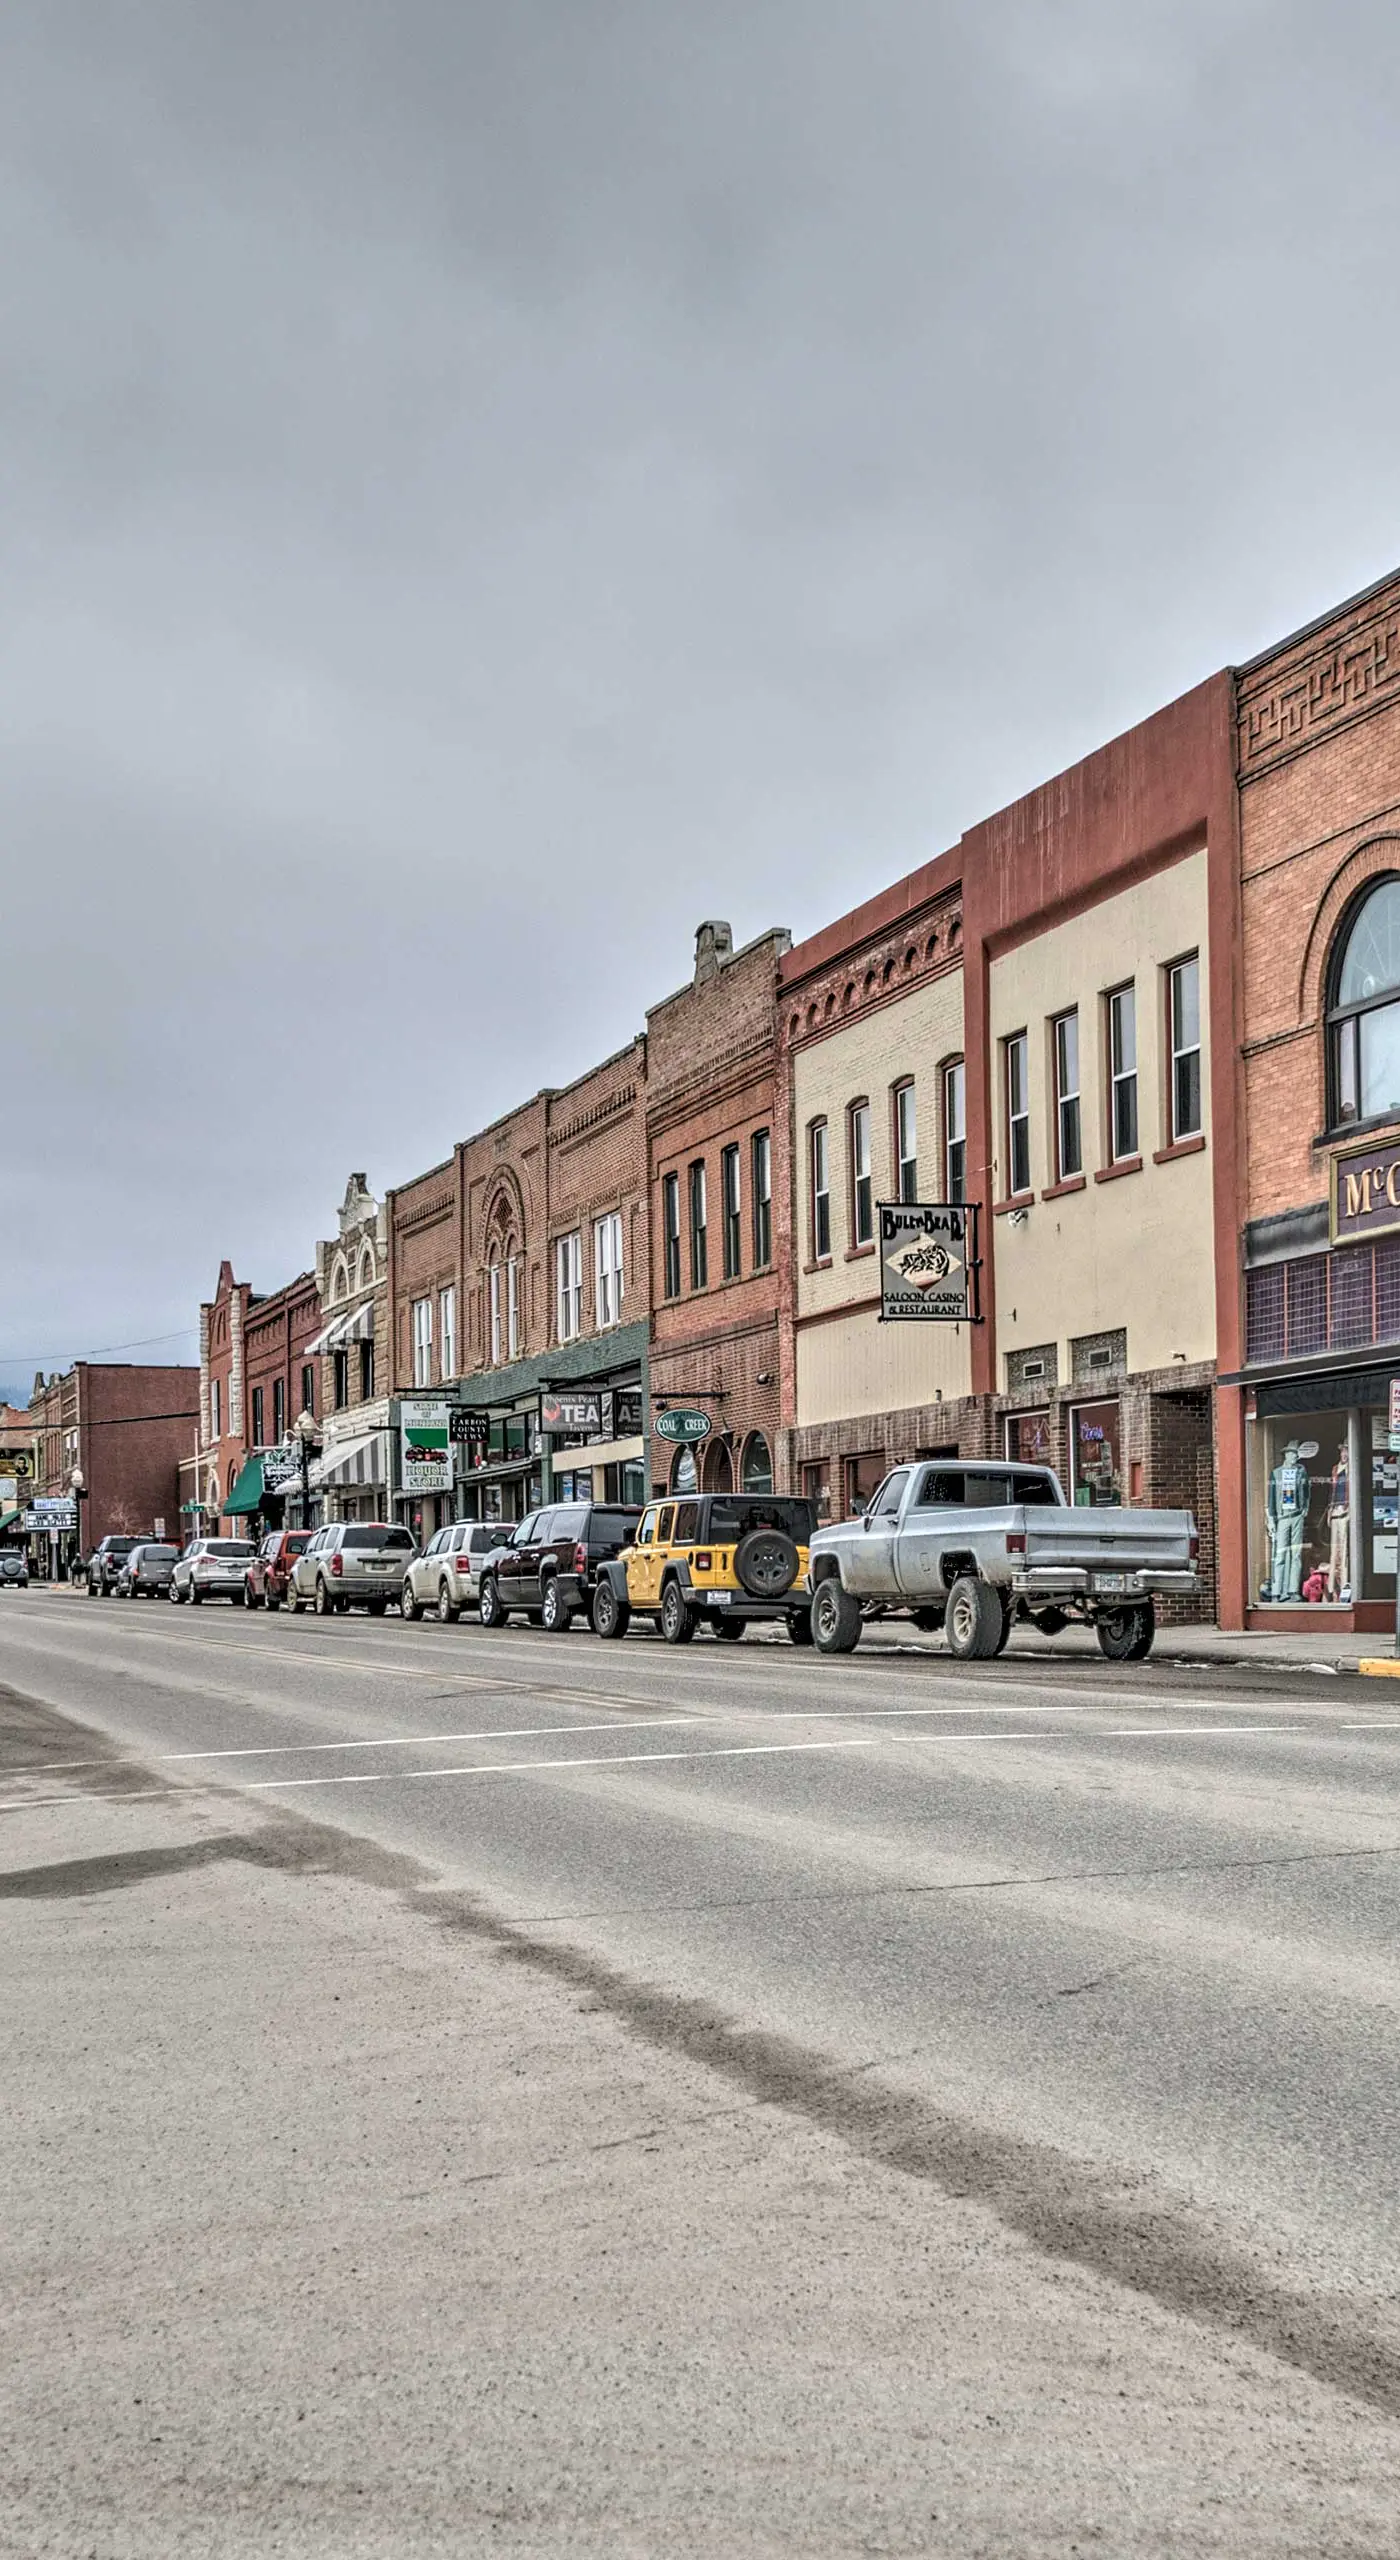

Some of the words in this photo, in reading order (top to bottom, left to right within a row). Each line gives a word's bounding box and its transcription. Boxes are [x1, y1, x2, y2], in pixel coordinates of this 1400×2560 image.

[928, 1292, 964, 1303] CASINO
[899, 1304, 961, 1315] RESTAURANT
[578, 1394, 598, 1403] Pearl
[560, 1404, 599, 1423] TEA
[568, 1423, 593, 1432] Tavern
[657, 1419, 677, 1432] COAL
[684, 1418, 707, 1432] CREEK
[405, 1465, 448, 1477] LIQUOR
[409, 1477, 445, 1487] STORE
